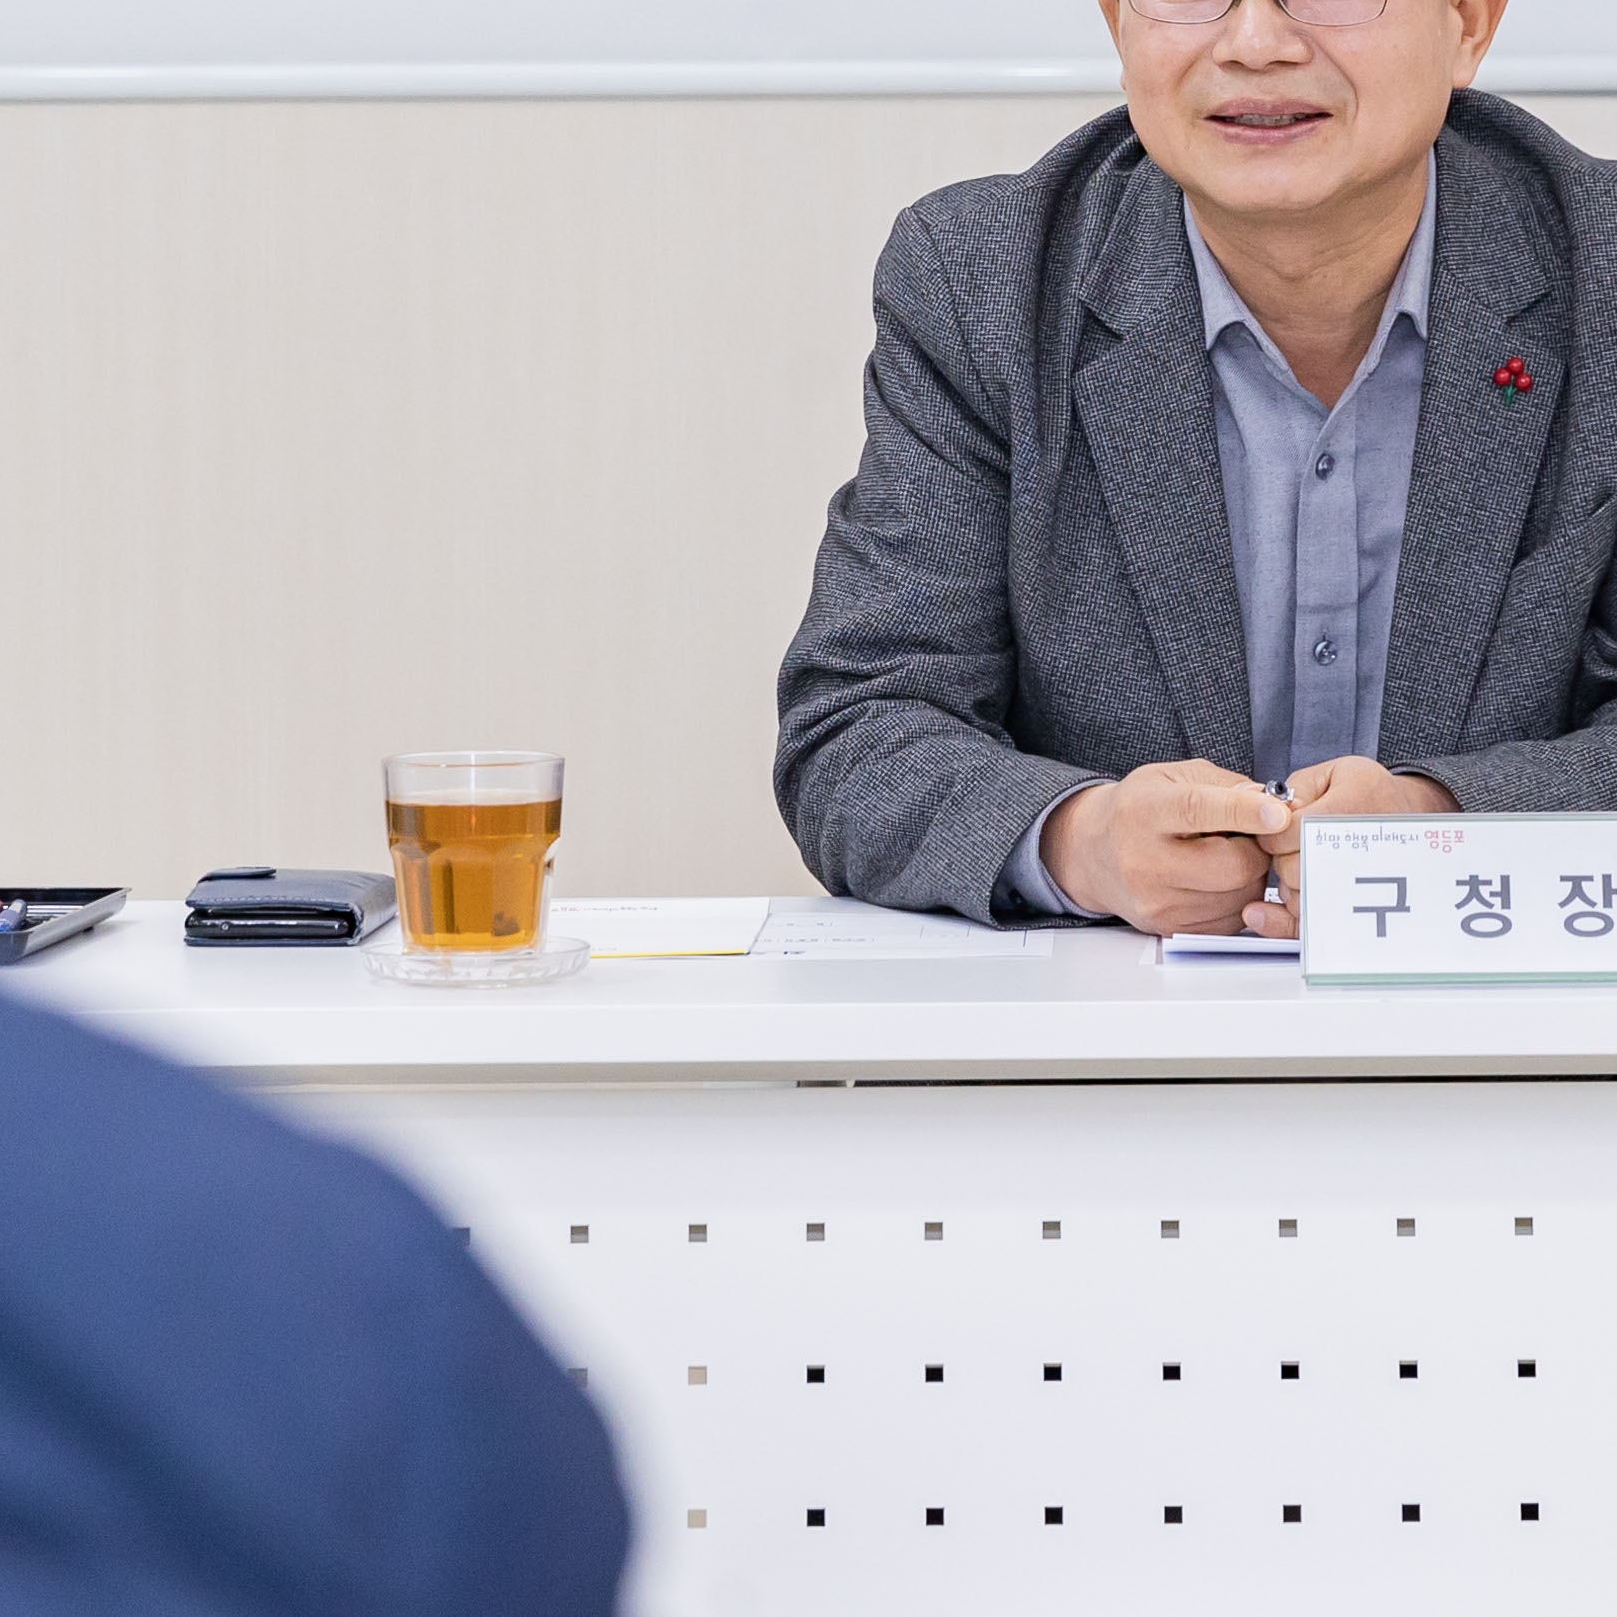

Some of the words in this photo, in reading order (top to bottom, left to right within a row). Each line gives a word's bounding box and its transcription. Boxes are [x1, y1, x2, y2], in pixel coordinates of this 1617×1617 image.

[1316, 824, 1340, 849] 희망
[1344, 829, 1369, 852] 행복
[1371, 825, 1419, 845] 미래도시
[1424, 830, 1465, 854] 영등포
